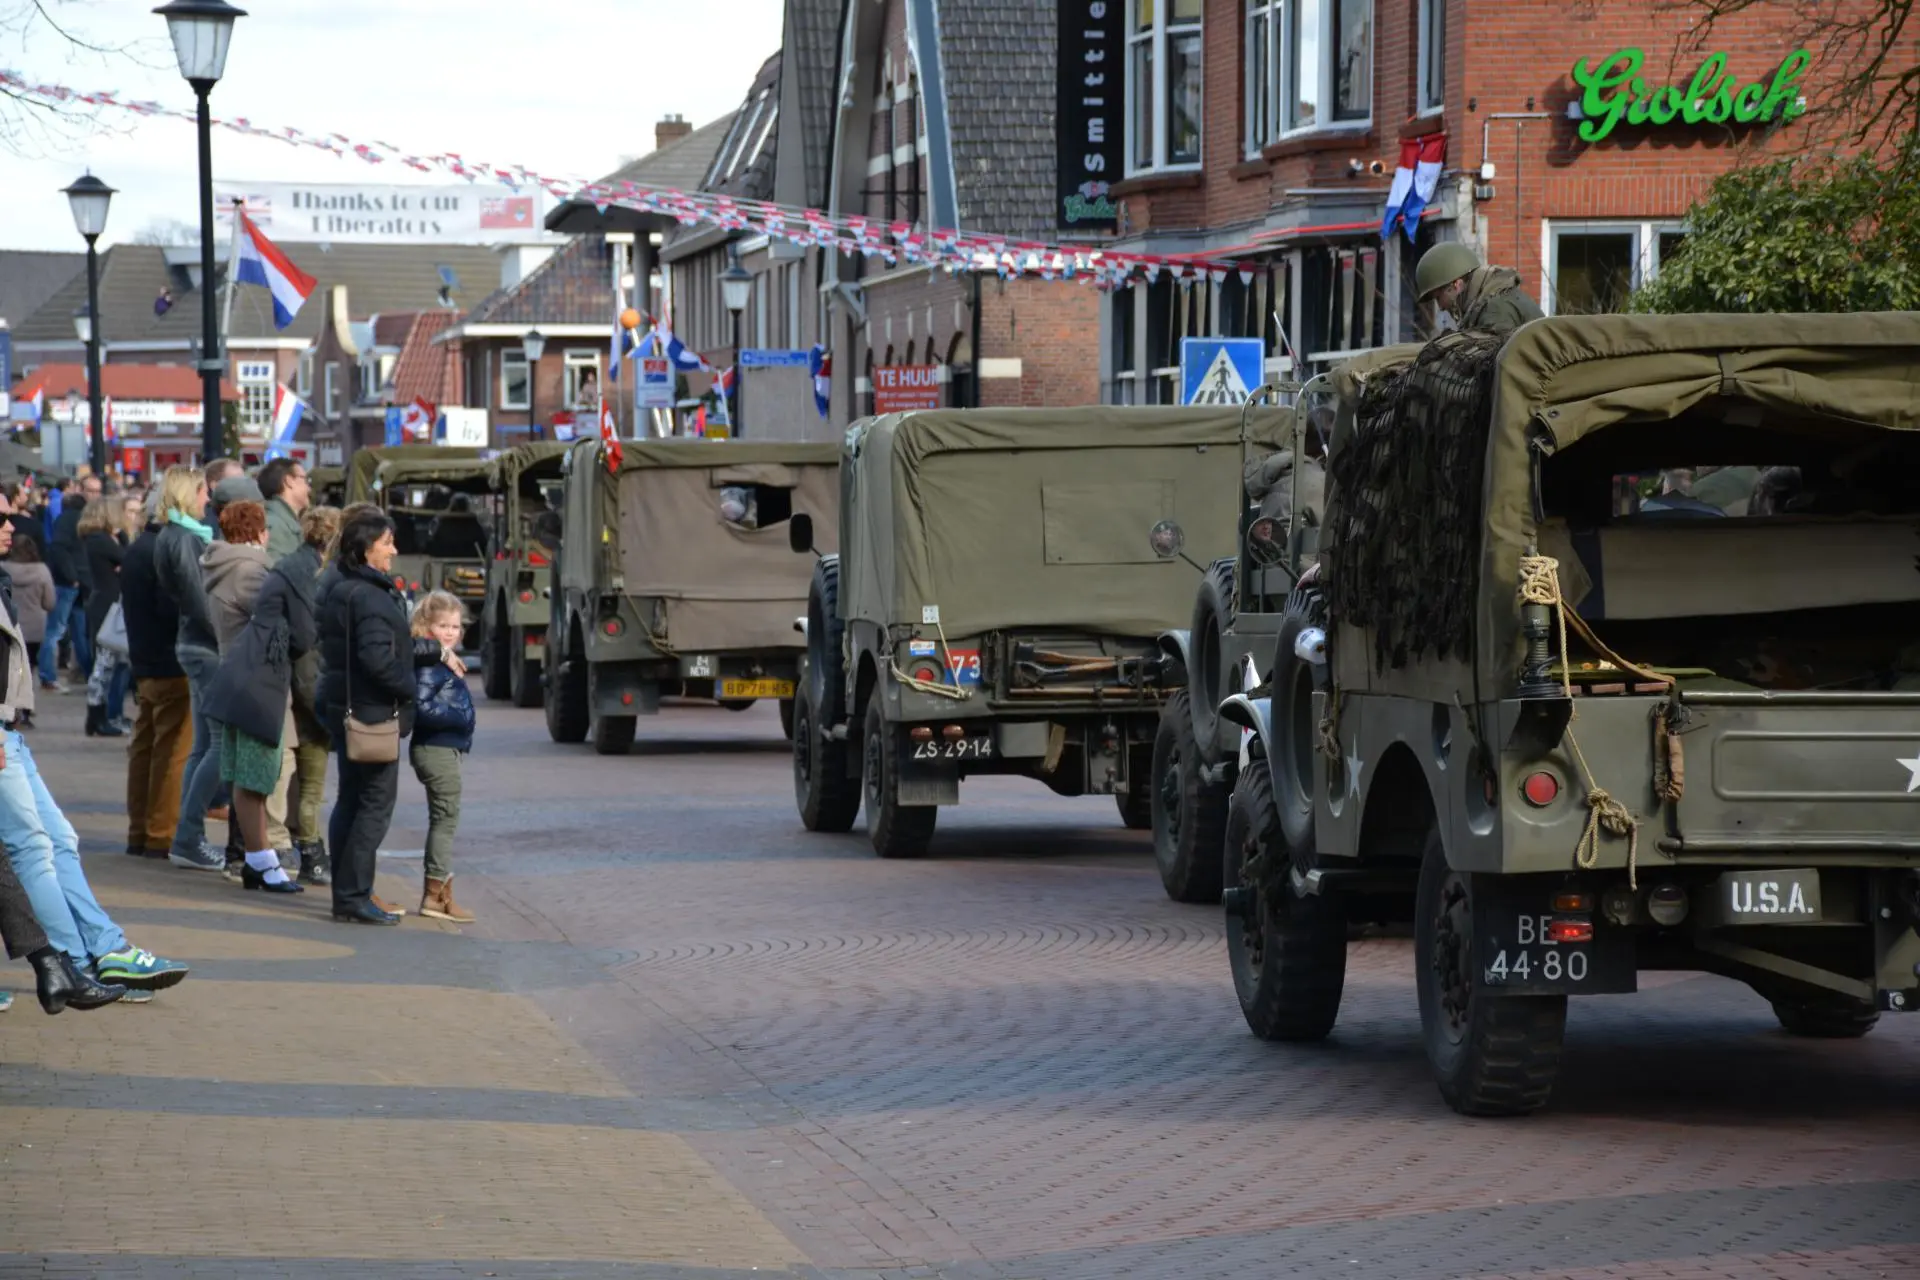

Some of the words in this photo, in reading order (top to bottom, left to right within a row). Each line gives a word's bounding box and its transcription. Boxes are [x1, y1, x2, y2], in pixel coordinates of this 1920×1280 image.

[1573, 47, 1811, 142] Grolsch
[292, 191, 384, 211] Thanks
[392, 194, 407, 211] to
[419, 196, 459, 211] our
[312, 215, 441, 235] Liberators
[877, 369, 896, 386] TE
[953, 655, 981, 679] 73
[1732, 881, 1814, 913] U.S.A.
